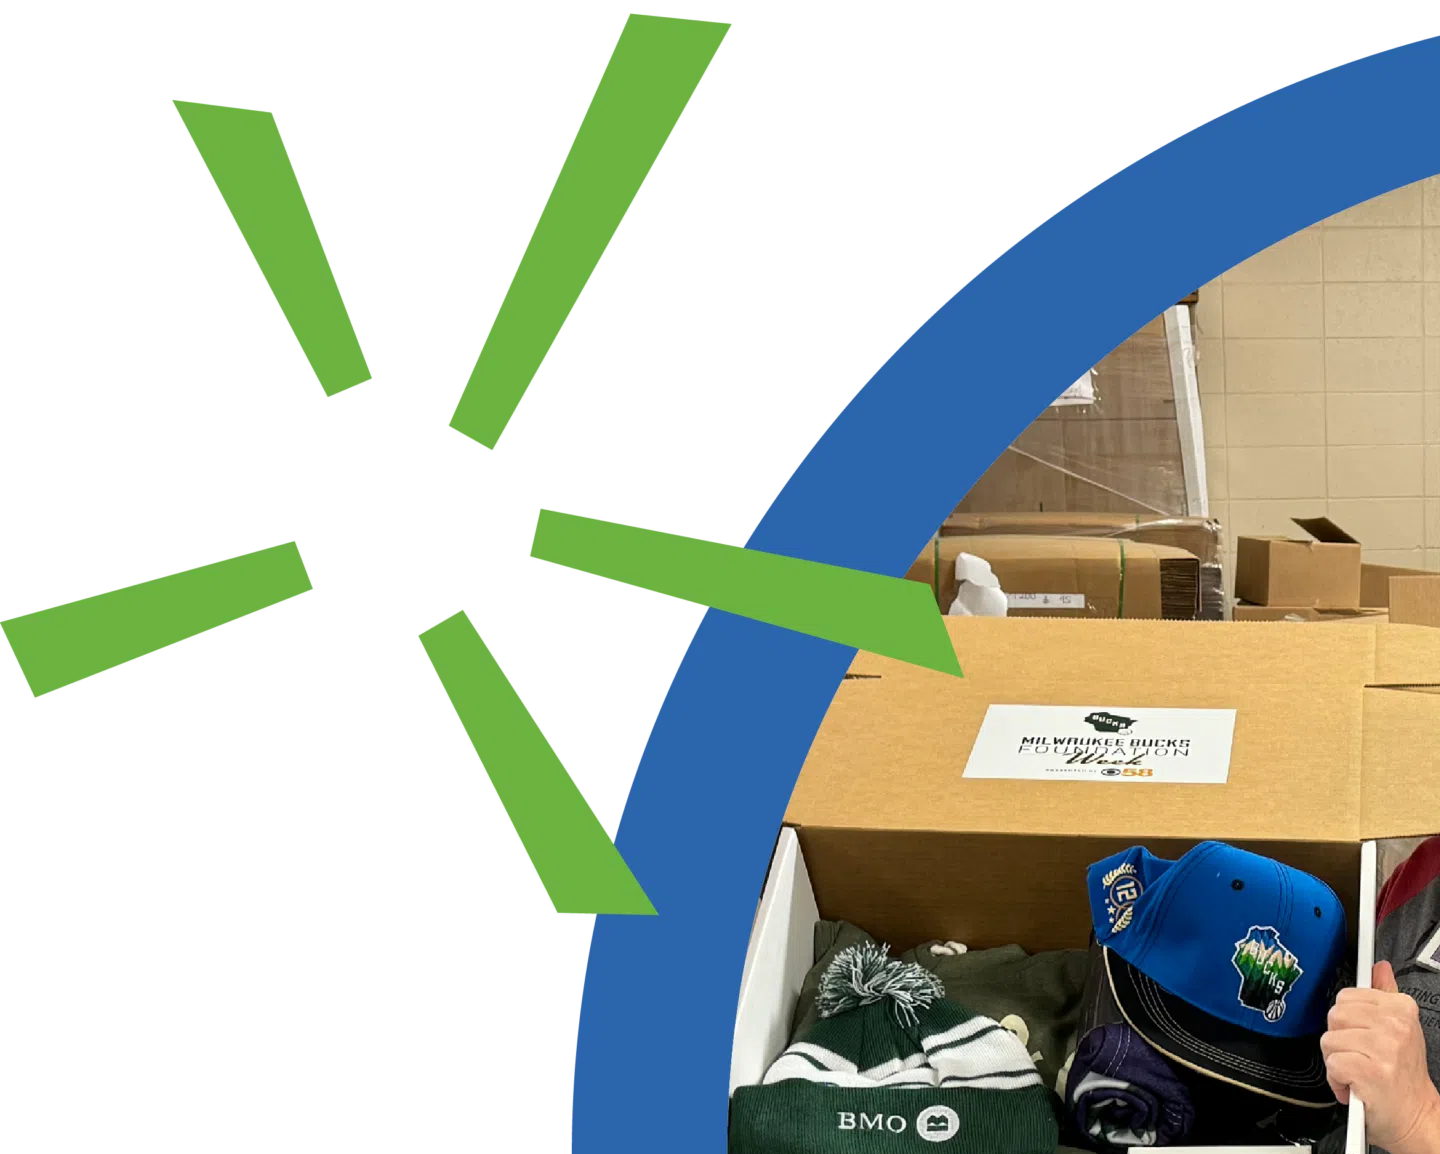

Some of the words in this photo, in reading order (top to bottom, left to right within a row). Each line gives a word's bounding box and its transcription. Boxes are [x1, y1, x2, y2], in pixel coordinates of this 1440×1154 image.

[1021, 736, 1126, 747] MILWAUKEE
[1129, 738, 1191, 748] BUCKS
[1018, 745, 1190, 757] FOUNDATION
[1064, 751, 1146, 766] Week
[1121, 768, 1153, 777] 58
[1115, 880, 1138, 902] 12
[1249, 942, 1285, 994] BUCKS
[836, 1111, 907, 1133] BMO
